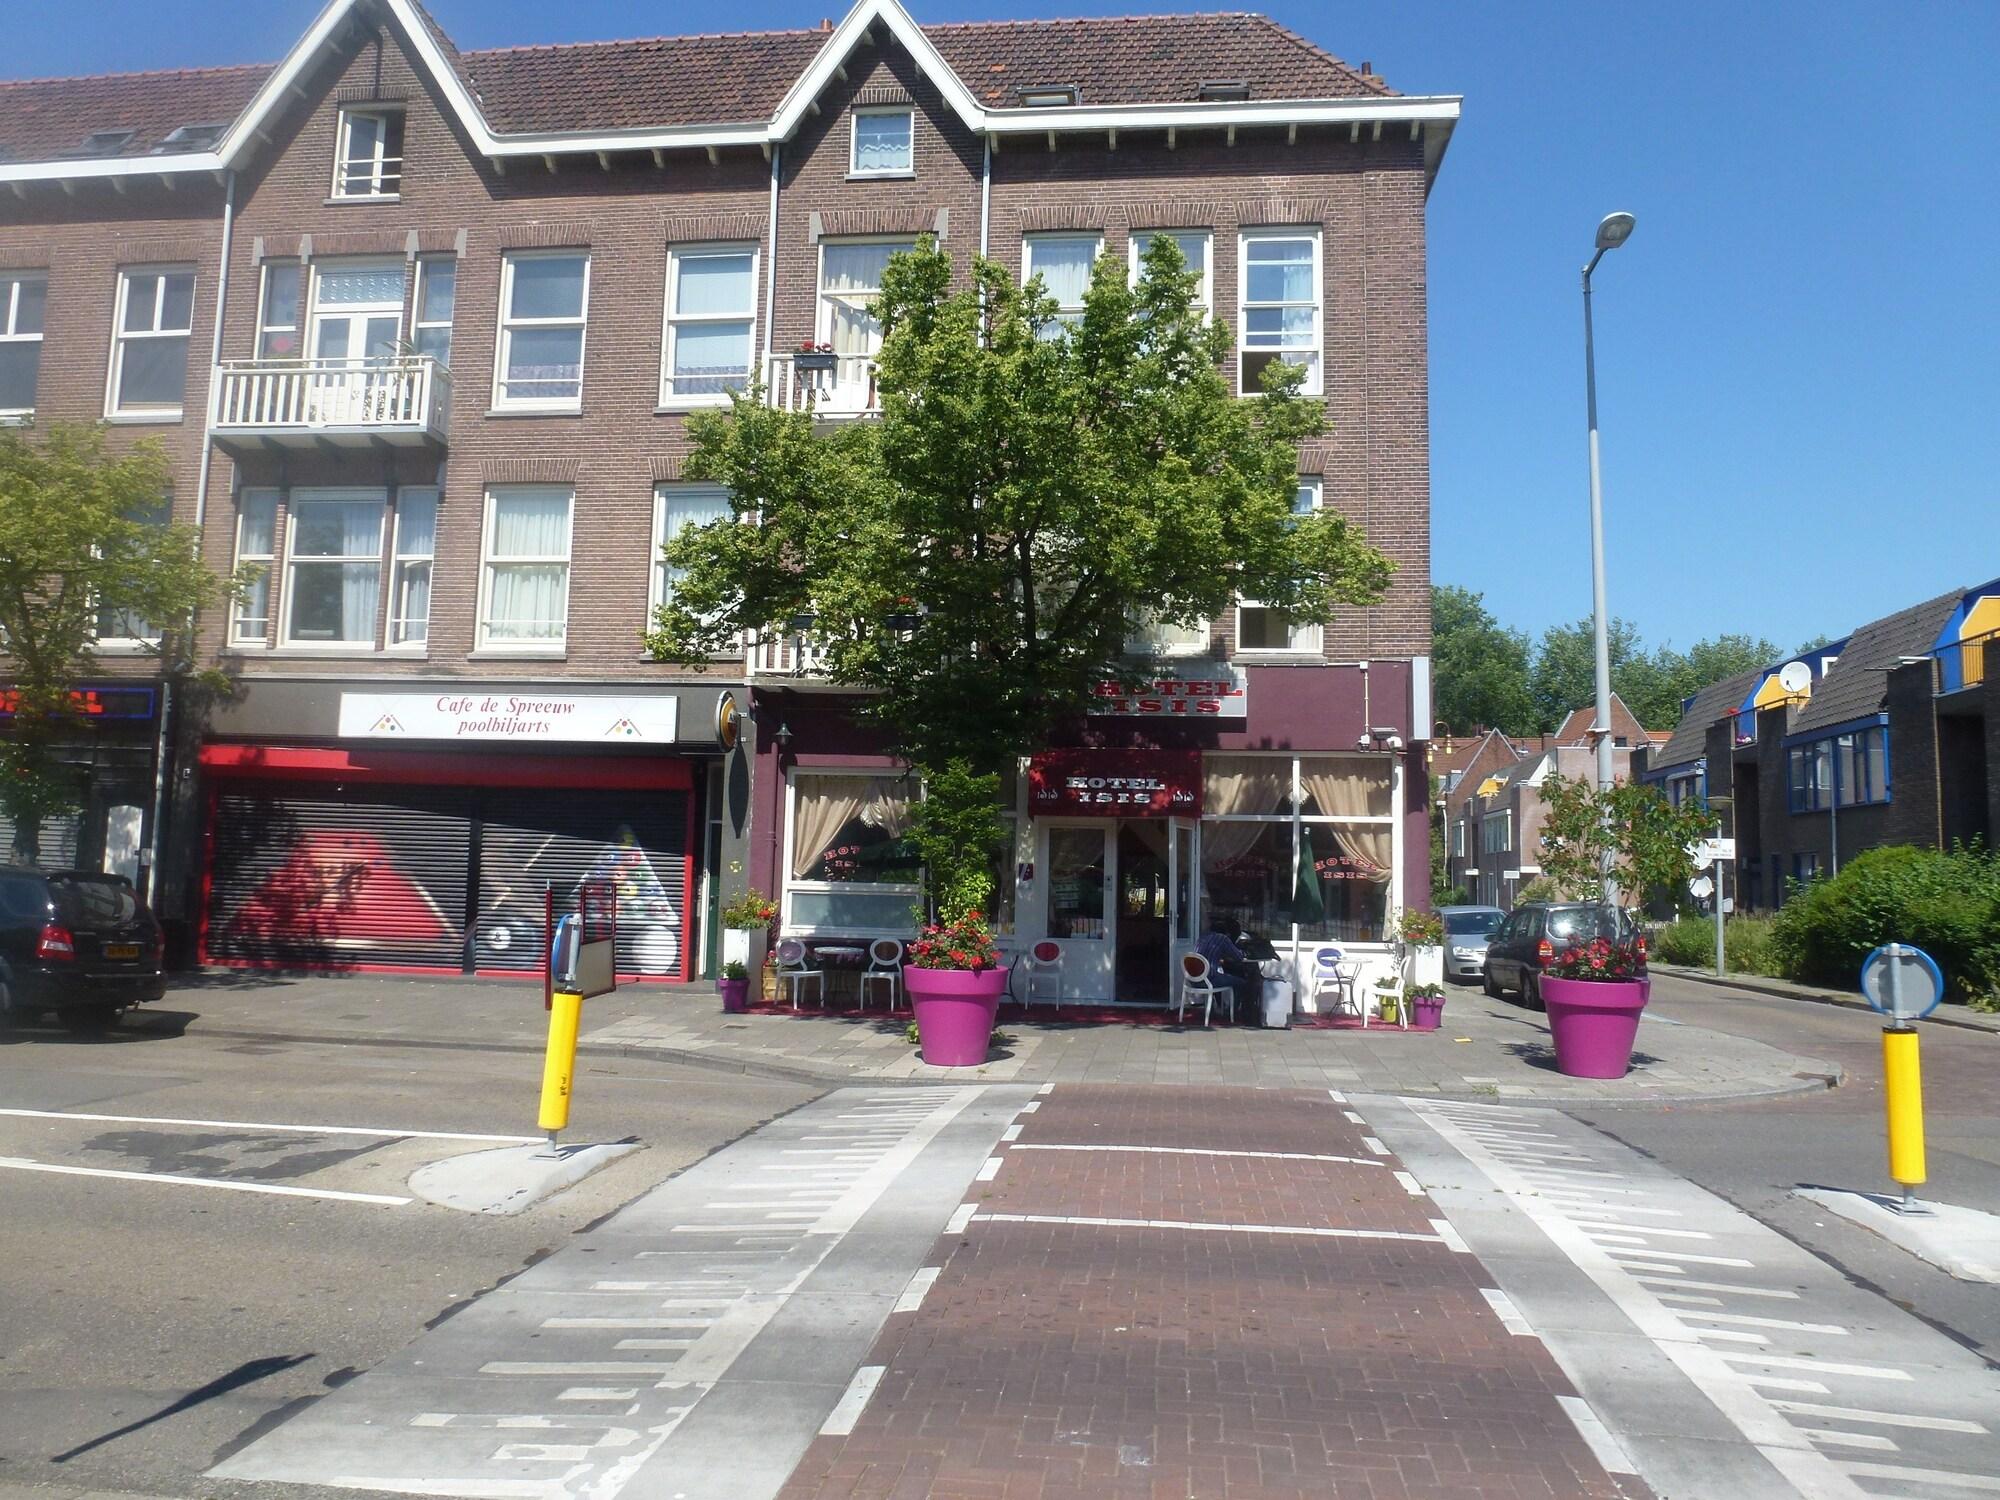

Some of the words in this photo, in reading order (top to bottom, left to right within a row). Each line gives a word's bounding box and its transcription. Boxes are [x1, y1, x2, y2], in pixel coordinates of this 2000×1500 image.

[436, 697, 473, 715] Cafe
[480, 697, 498, 713] de
[506, 697, 575, 716] Spreeuw
[1113, 700, 1221, 713] ISIS
[457, 717, 550, 735] poolbiljarts
[1065, 776, 1166, 790] HOTEL
[1079, 792, 1151, 804] ISIS
[1313, 856, 1377, 872] HOTEL
[1323, 871, 1368, 879] ISIS
